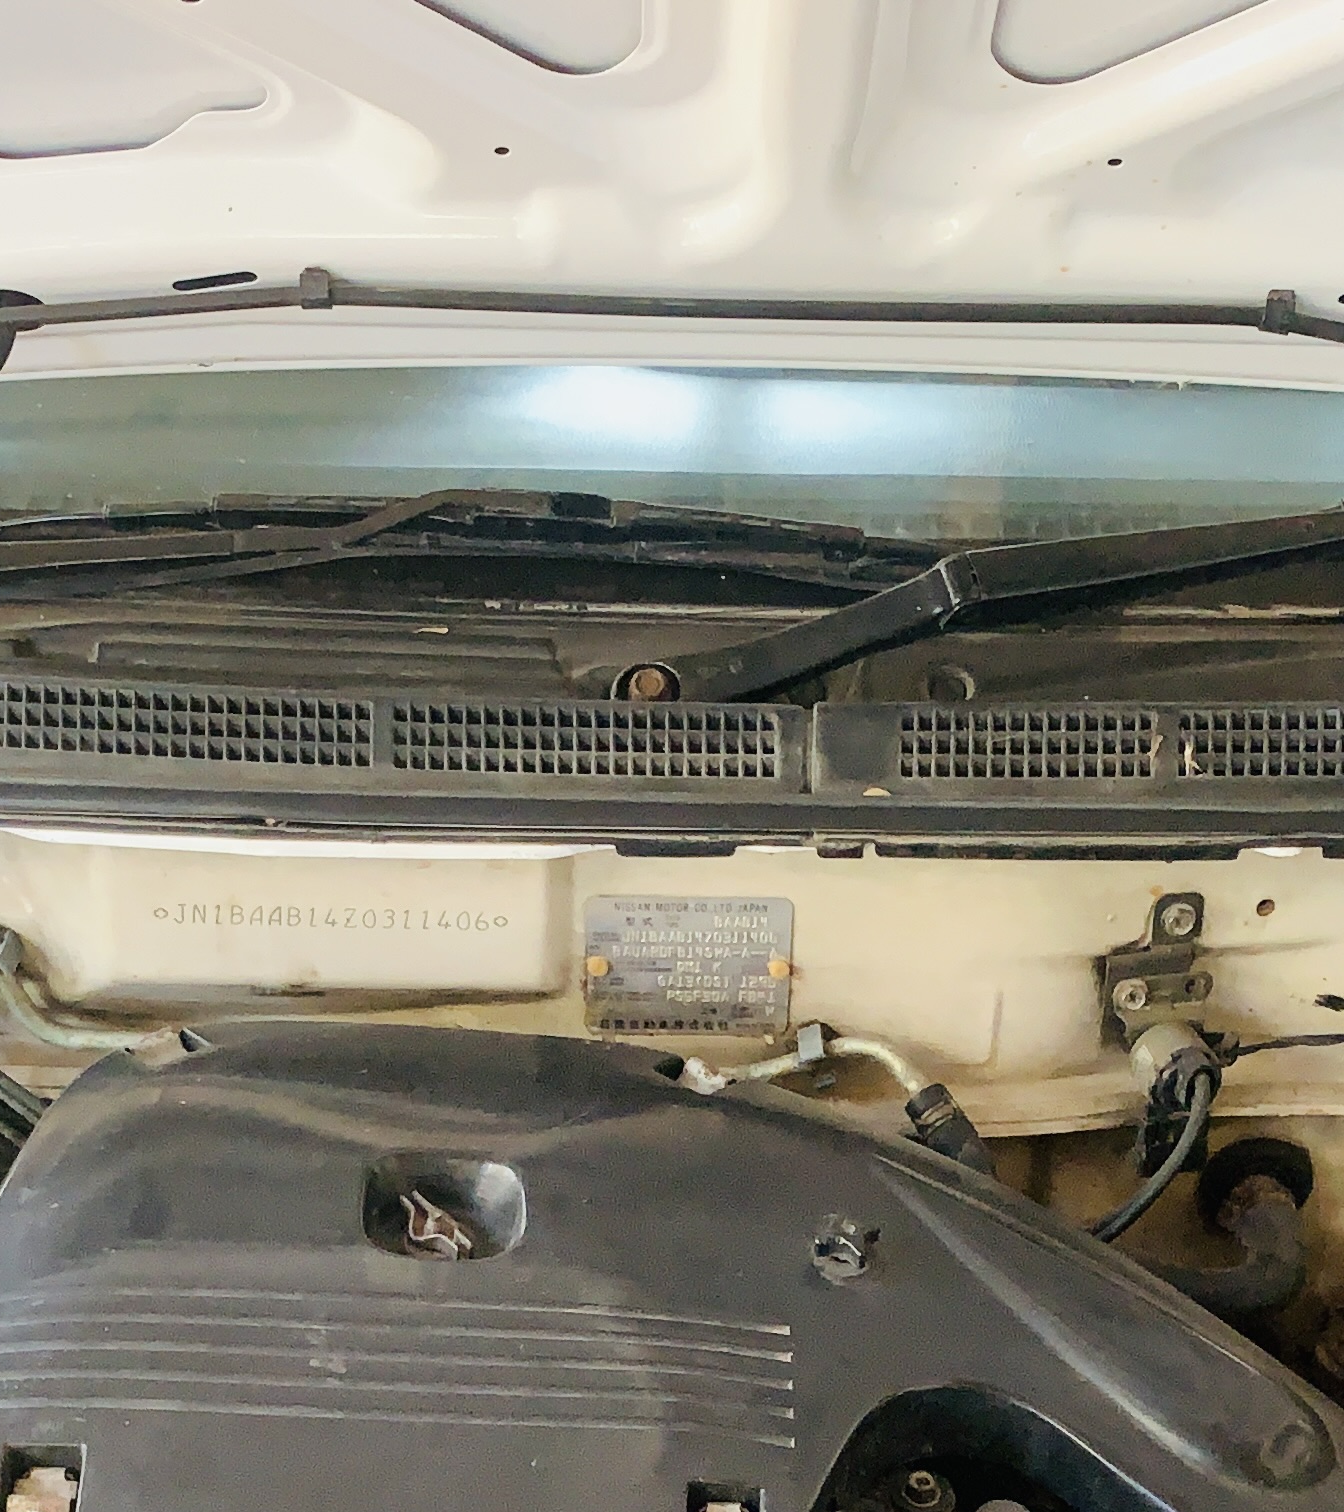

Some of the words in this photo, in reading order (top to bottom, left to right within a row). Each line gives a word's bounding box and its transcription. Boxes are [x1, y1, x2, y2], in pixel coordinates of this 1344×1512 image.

[614, 903, 650, 912] NISSAN
[656, 903, 688, 912] MOTOR
[173, 903, 490, 931] JN1BAAB14Z0311406
